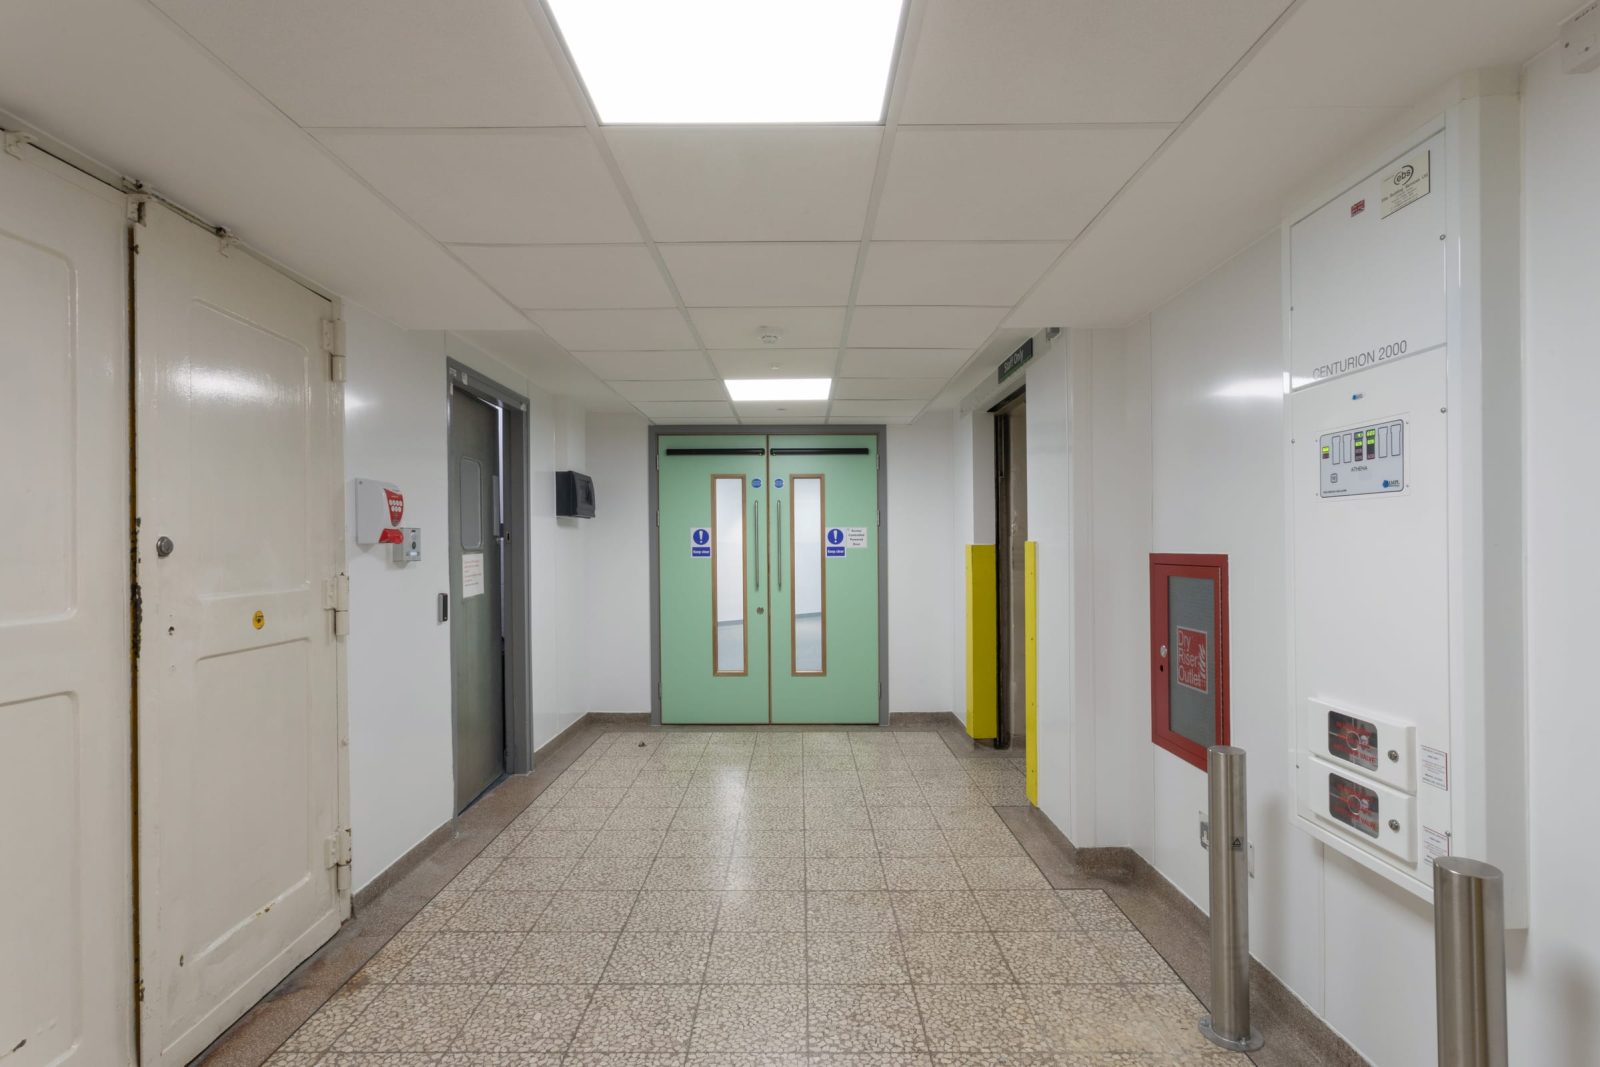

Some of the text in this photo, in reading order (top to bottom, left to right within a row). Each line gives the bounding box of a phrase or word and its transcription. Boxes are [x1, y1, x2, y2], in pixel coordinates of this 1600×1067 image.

[1312, 340, 1407, 380] CENTURION 2000
[1178, 630, 1191, 652] Dry
[1178, 648, 1199, 668] Riser
[1178, 665, 1201, 687] Outlet
